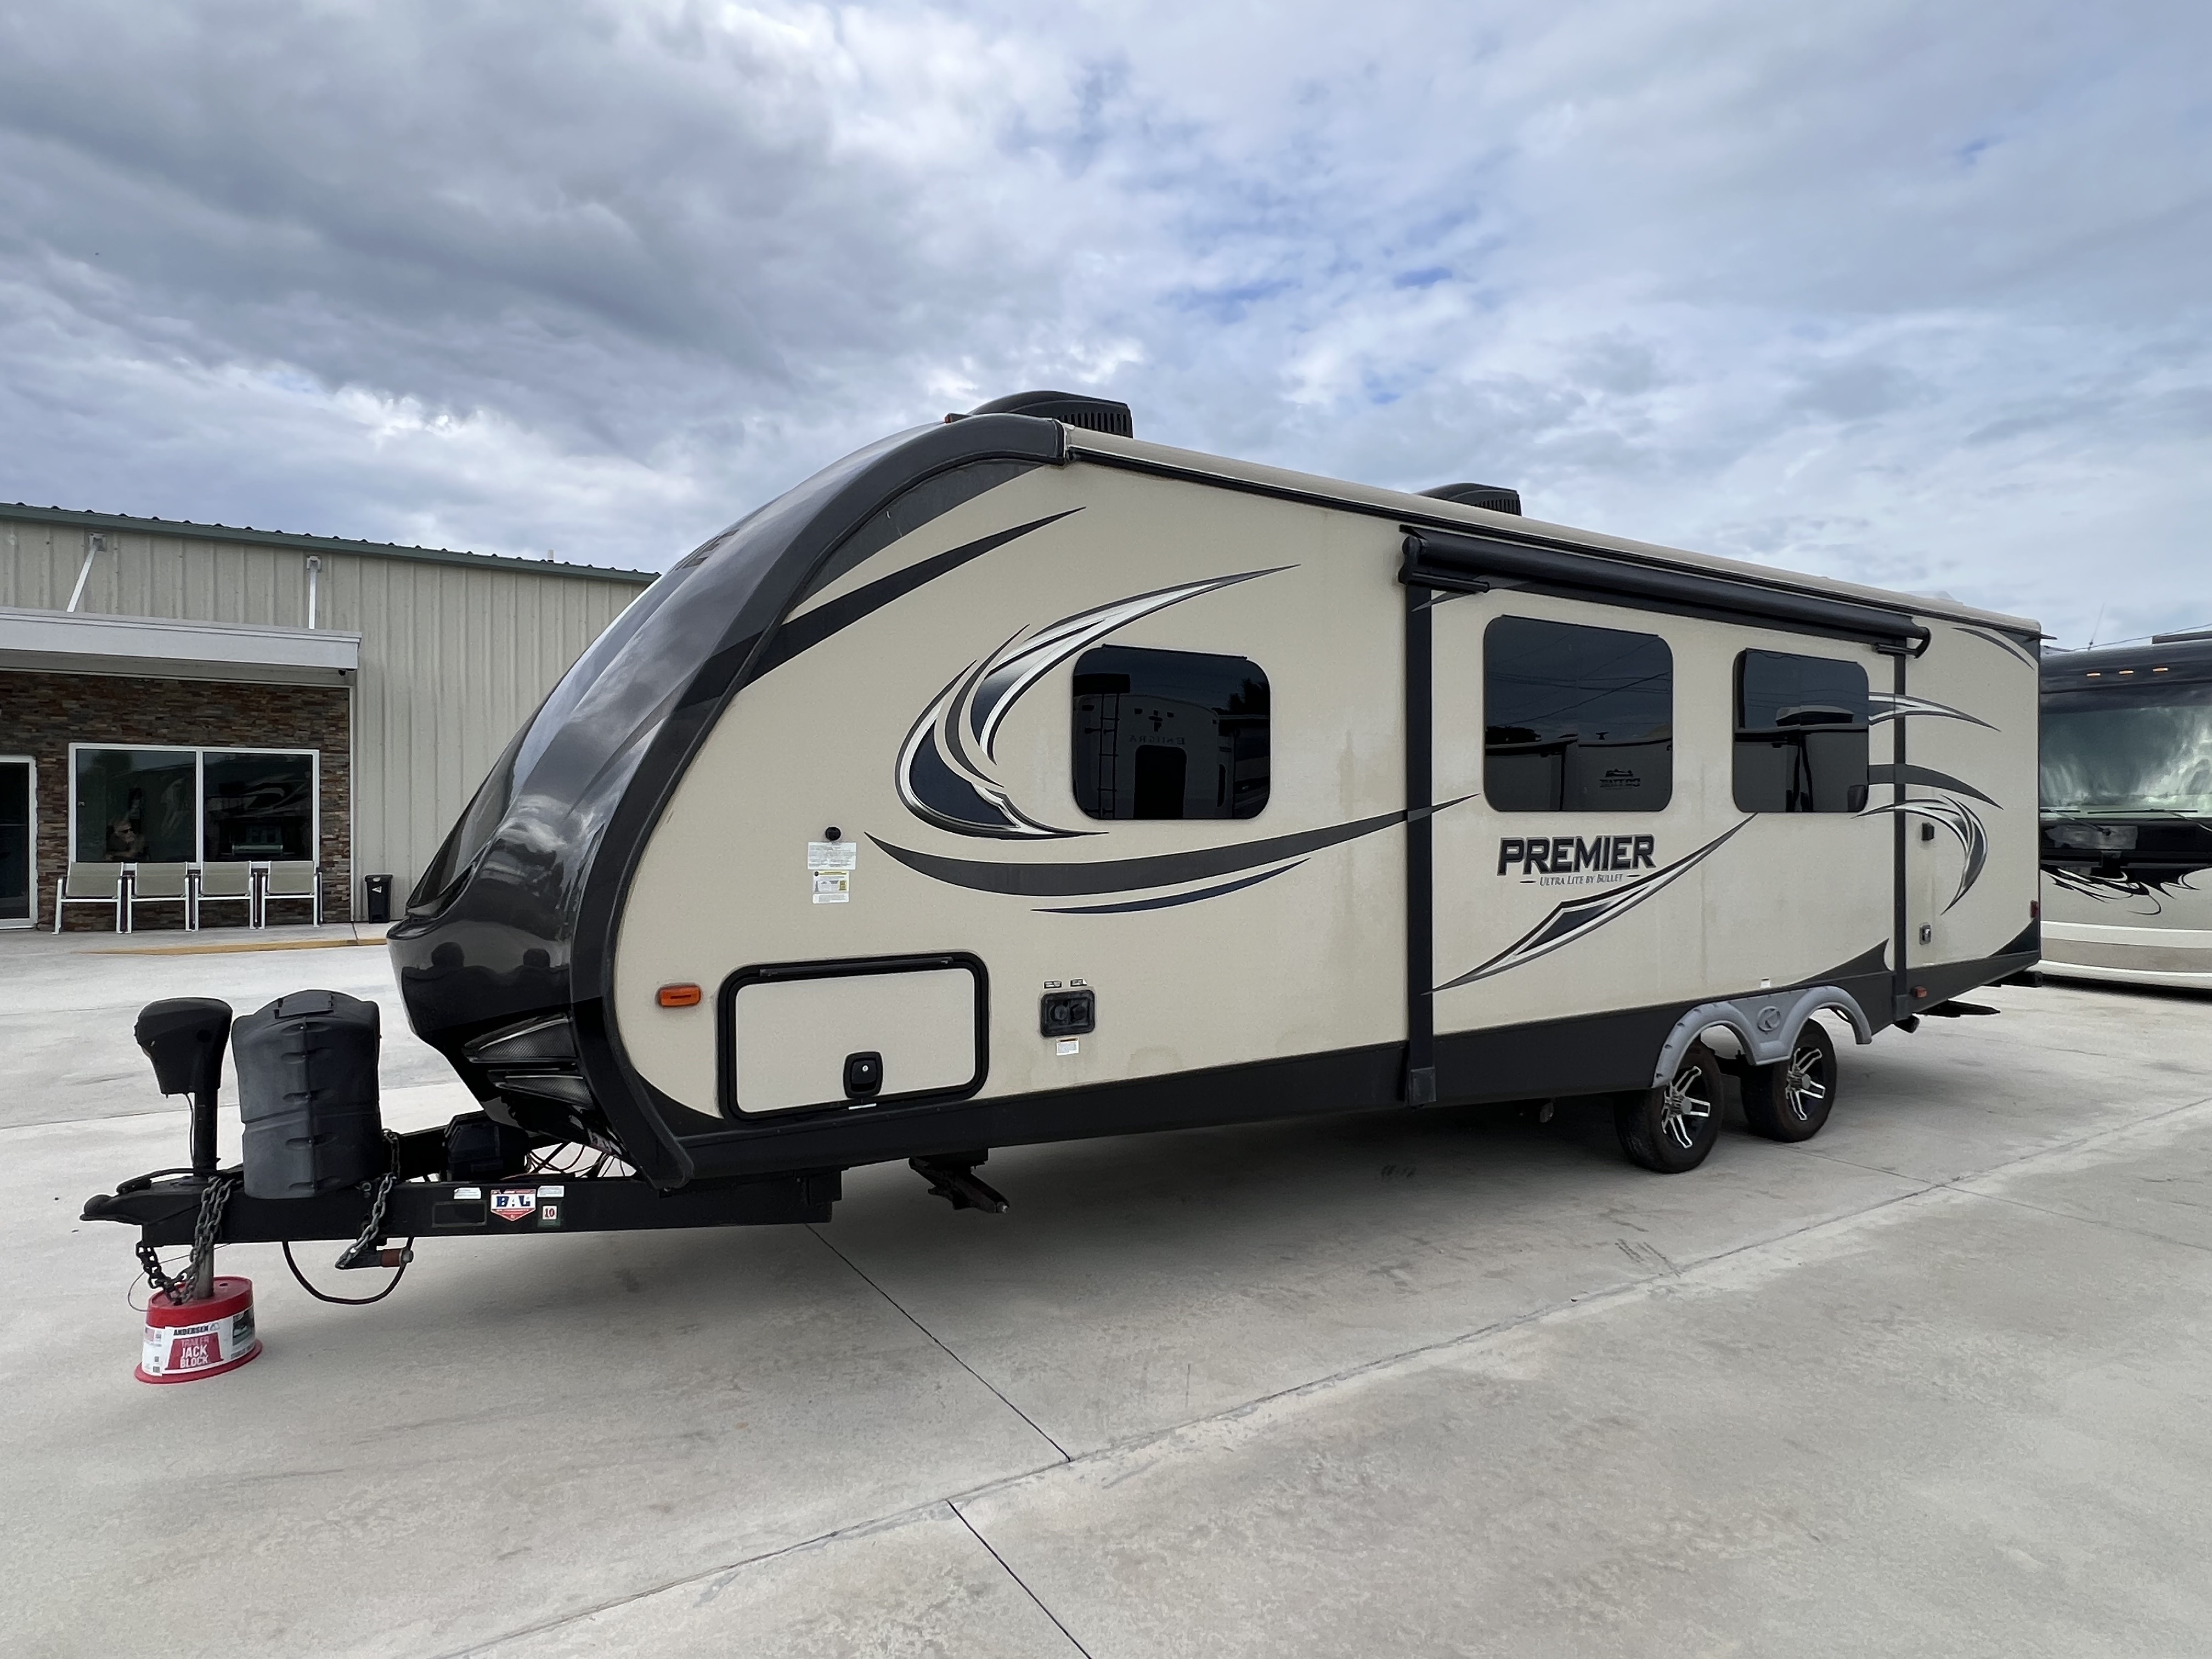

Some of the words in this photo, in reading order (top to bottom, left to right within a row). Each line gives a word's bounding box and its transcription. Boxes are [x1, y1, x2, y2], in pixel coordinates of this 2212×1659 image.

[1497, 834, 1656, 876] PREMIER
[1539, 877, 1565, 886] ULTRA
[1567, 876, 1584, 884] LITE
[1596, 873, 1623, 883] BULLET
[544, 1208, 555, 1217] 10
[173, 1325, 208, 1336] ANDERSEN
[181, 1344, 207, 1358] JACK
[180, 1355, 208, 1368] BLOCK
